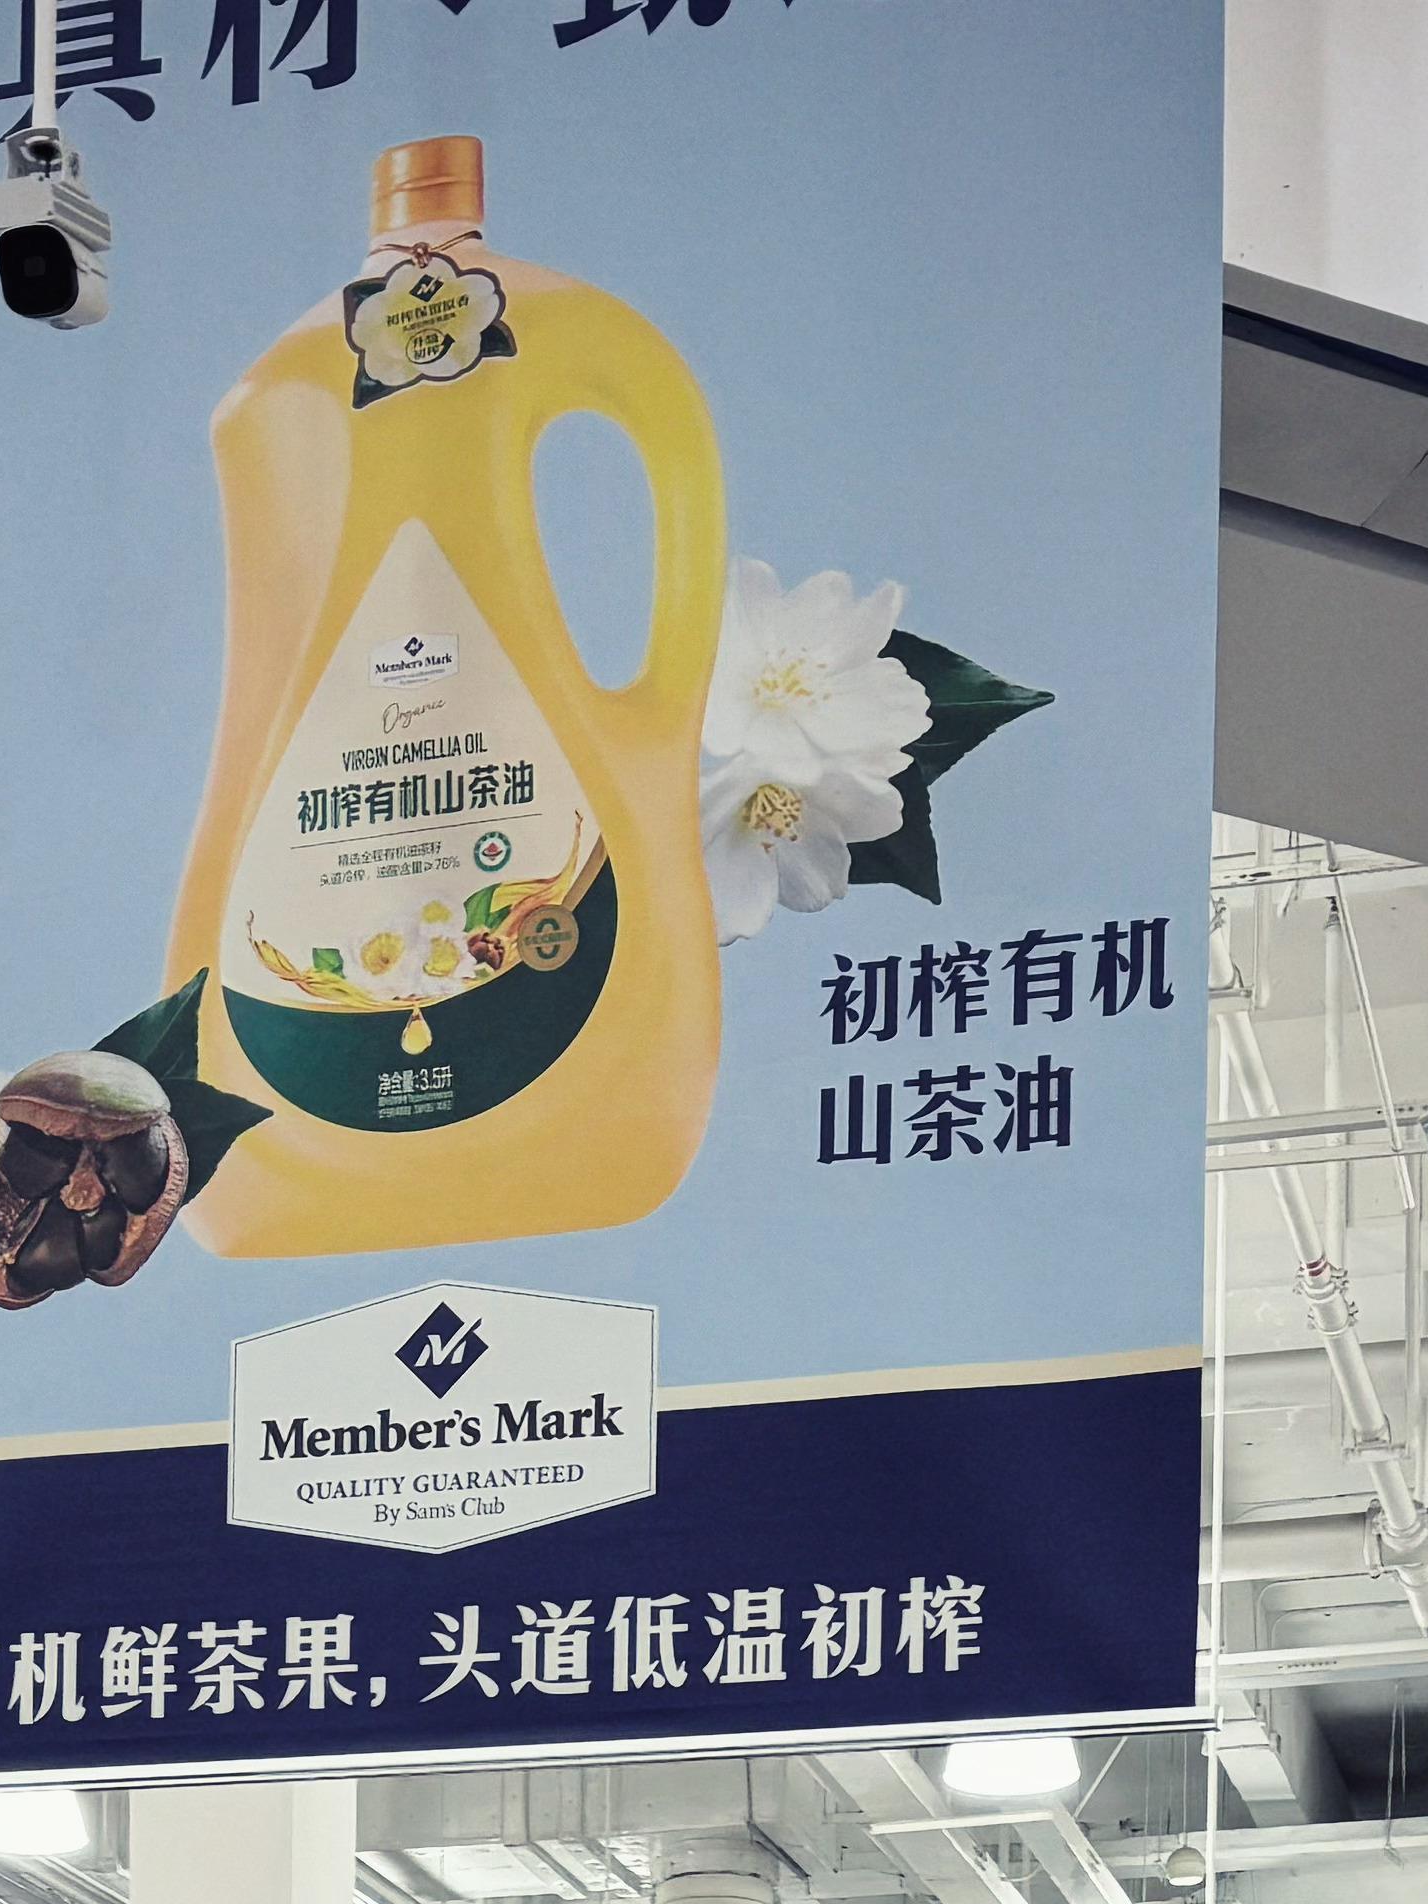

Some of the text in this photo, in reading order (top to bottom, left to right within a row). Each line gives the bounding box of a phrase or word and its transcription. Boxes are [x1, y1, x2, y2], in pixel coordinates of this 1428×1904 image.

[425, 653, 452, 668] Mark
[342, 732, 488, 772] VIRGIN CAMELLIA OIL
[296, 759, 535, 835] 初榨有机山茶油
[819, 917, 1175, 1045] 初榨有机
[816, 1054, 1074, 1165] 山茶油
[257, 1391, 625, 1462] Member's Mark
[295, 1460, 586, 1506] QUALITY GUARANTEED
[373, 1493, 506, 1526] By Sam's Club
